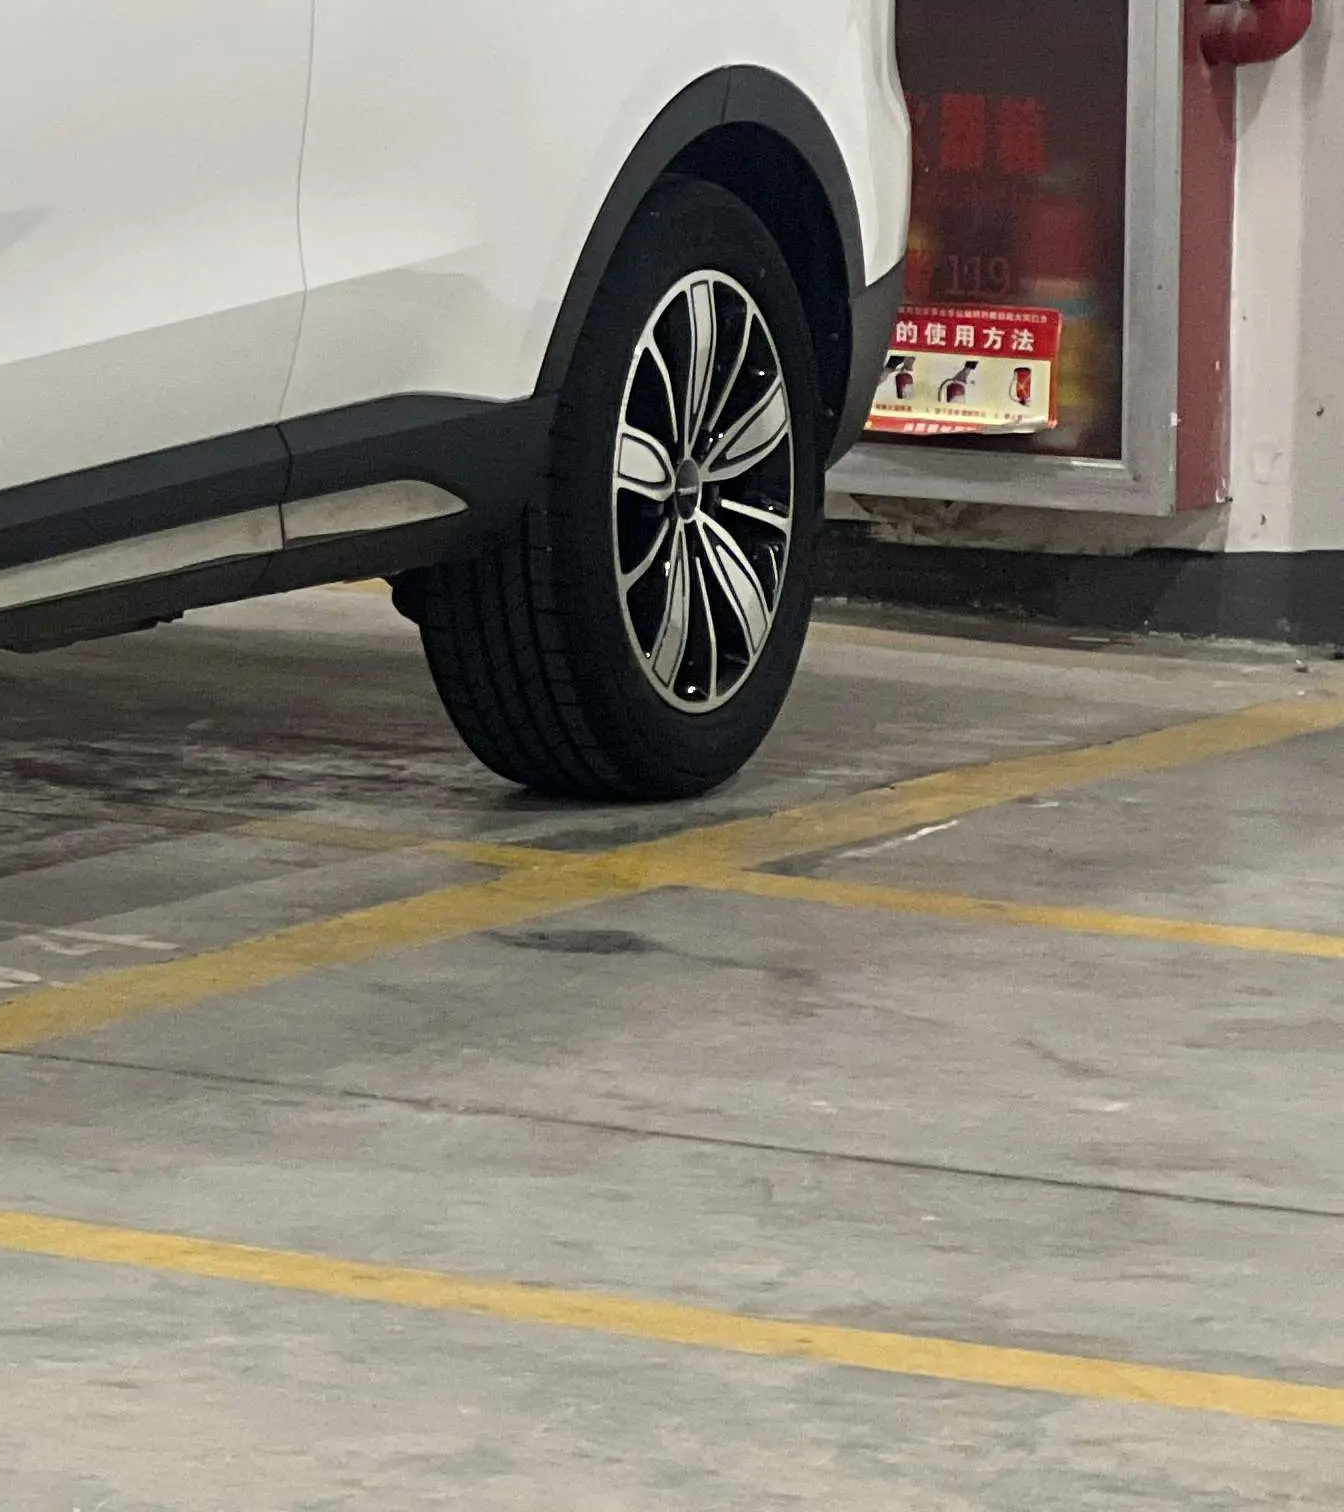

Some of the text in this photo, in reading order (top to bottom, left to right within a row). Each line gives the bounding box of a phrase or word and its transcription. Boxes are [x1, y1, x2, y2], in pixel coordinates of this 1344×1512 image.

[895, 320, 1035, 352] 的使用方法
